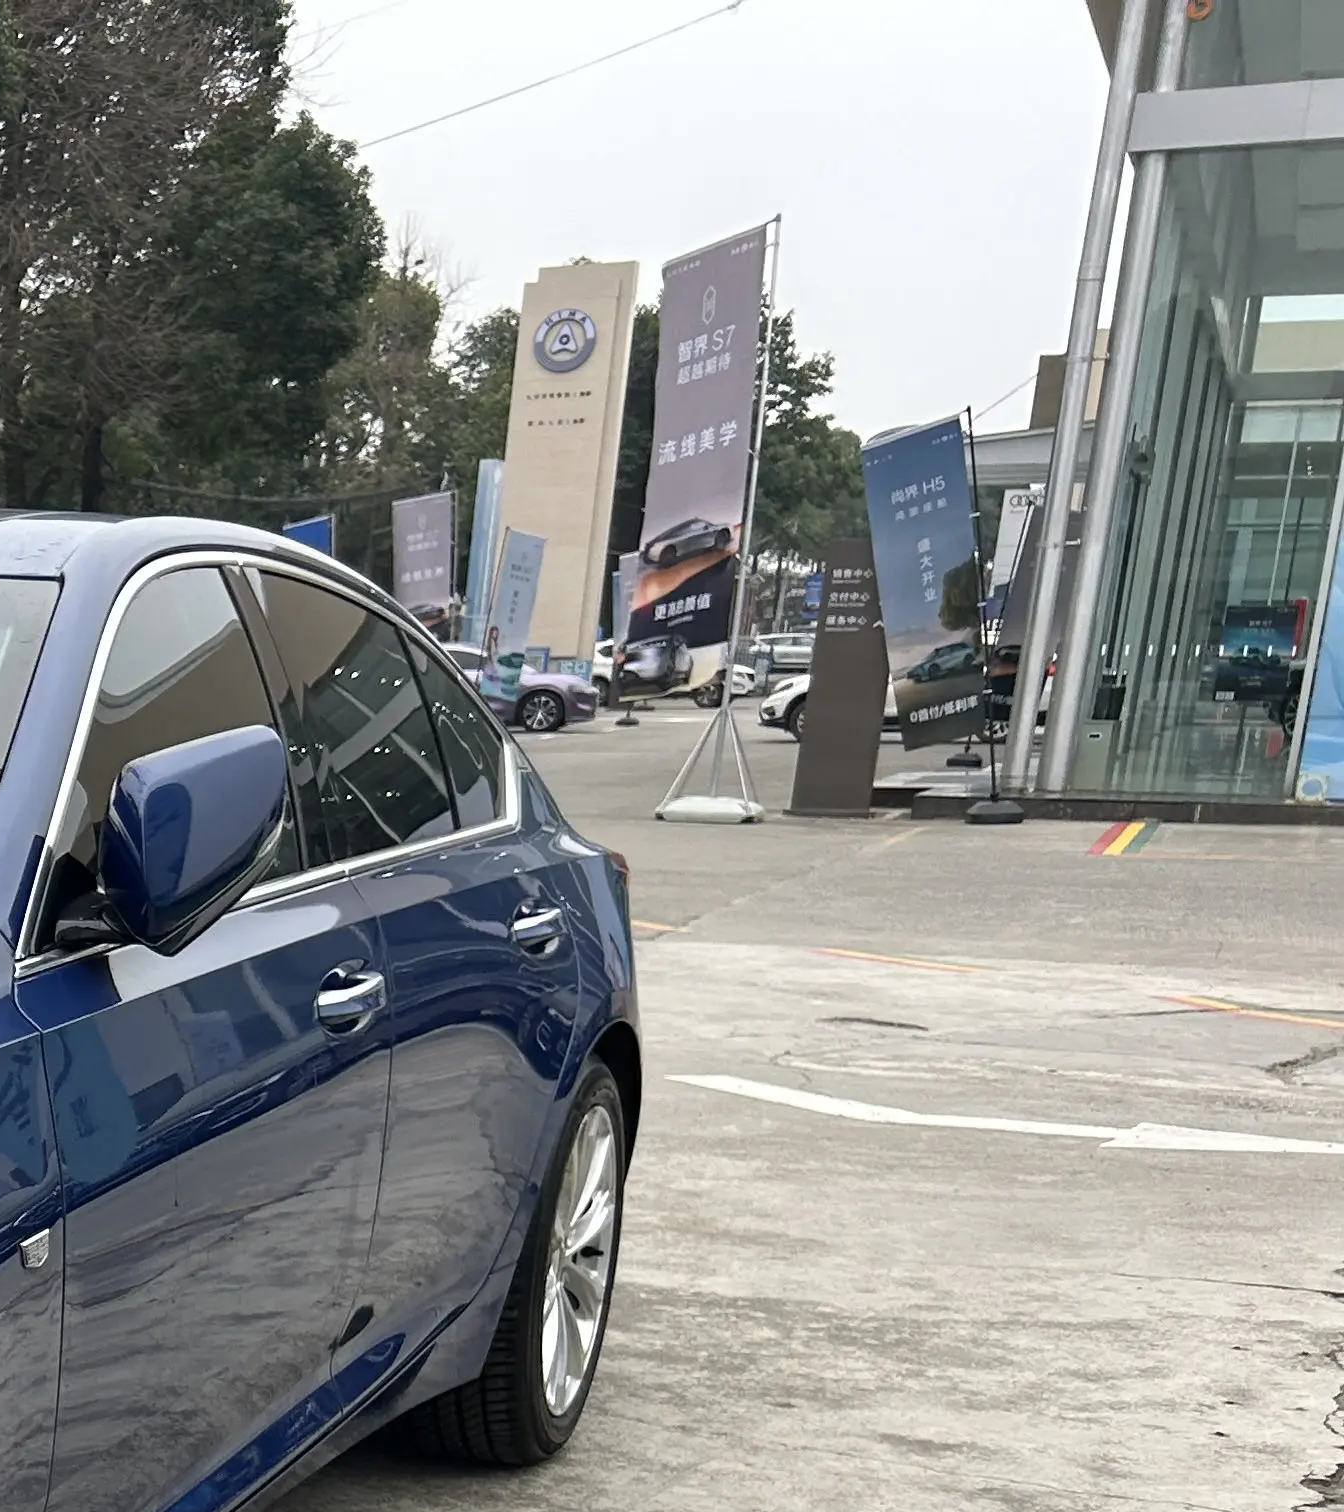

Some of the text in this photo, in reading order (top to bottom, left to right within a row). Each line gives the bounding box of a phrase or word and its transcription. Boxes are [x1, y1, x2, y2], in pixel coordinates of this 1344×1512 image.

[712, 325, 736, 351] S7
[658, 420, 738, 466] 流线美学
[922, 475, 946, 496] H5
